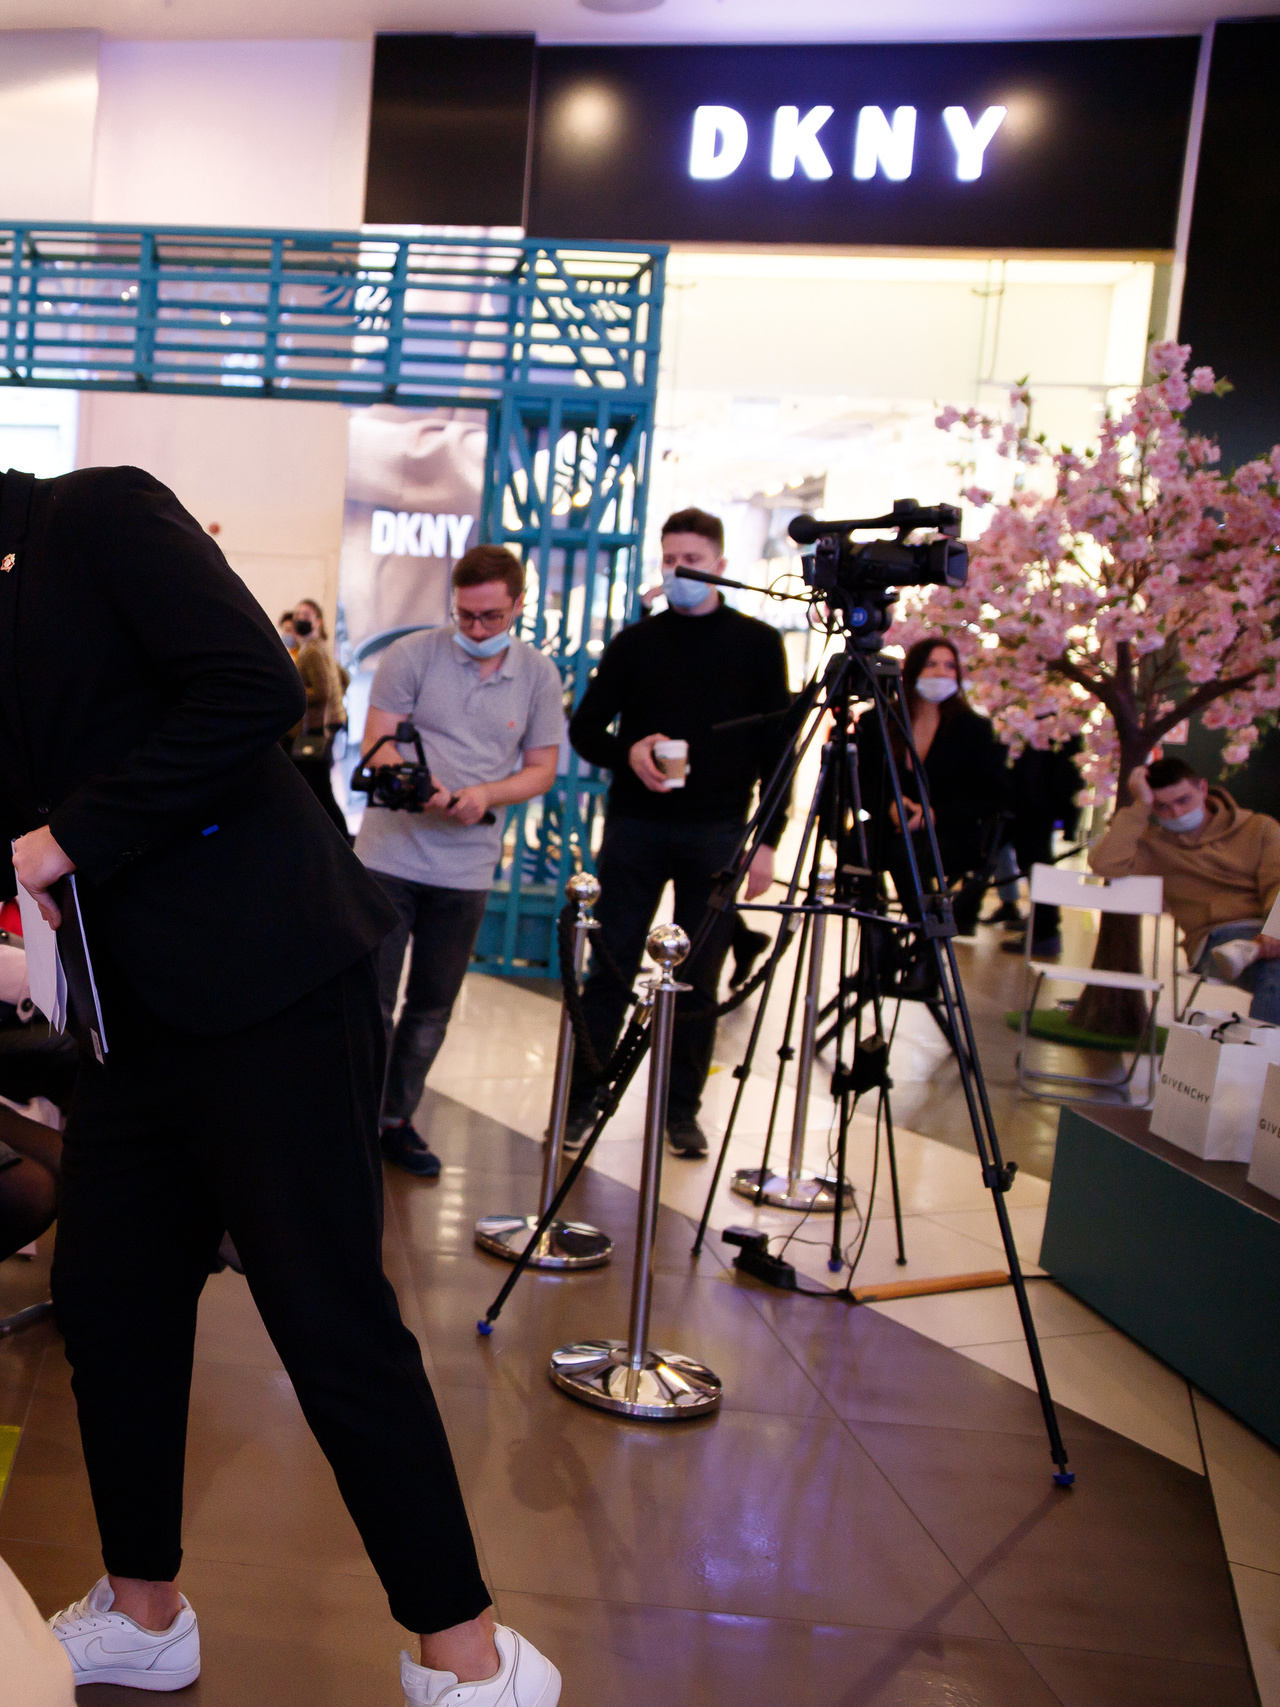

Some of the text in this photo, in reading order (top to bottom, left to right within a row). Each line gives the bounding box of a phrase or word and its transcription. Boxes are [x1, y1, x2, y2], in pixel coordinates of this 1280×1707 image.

[689, 105, 1008, 181] DKNY
[371, 510, 474, 559] DKNY
[1161, 1073, 1211, 1104] GIVENCHY
